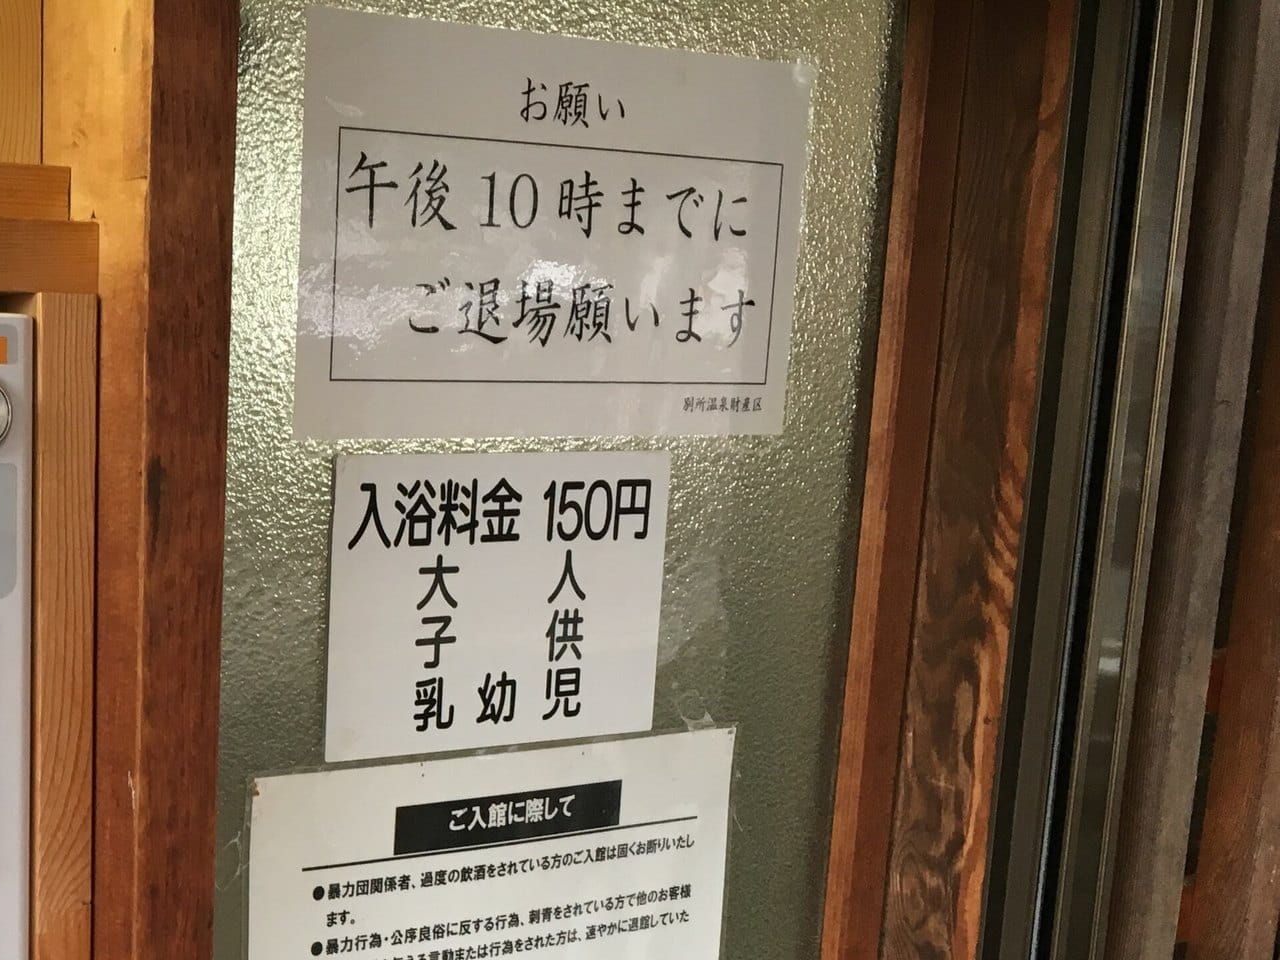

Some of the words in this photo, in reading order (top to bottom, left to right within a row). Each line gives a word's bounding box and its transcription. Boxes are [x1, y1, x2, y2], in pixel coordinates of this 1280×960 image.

[519, 77, 626, 128] お願い
[345, 151, 748, 241] 午後10時までに
[408, 278, 755, 348] ご退場願います
[347, 478, 523, 550] 入浴料金
[543, 478, 652, 542] 150円
[447, 794, 576, 831] ご入館に際して
[326, 909, 356, 928] ます。
